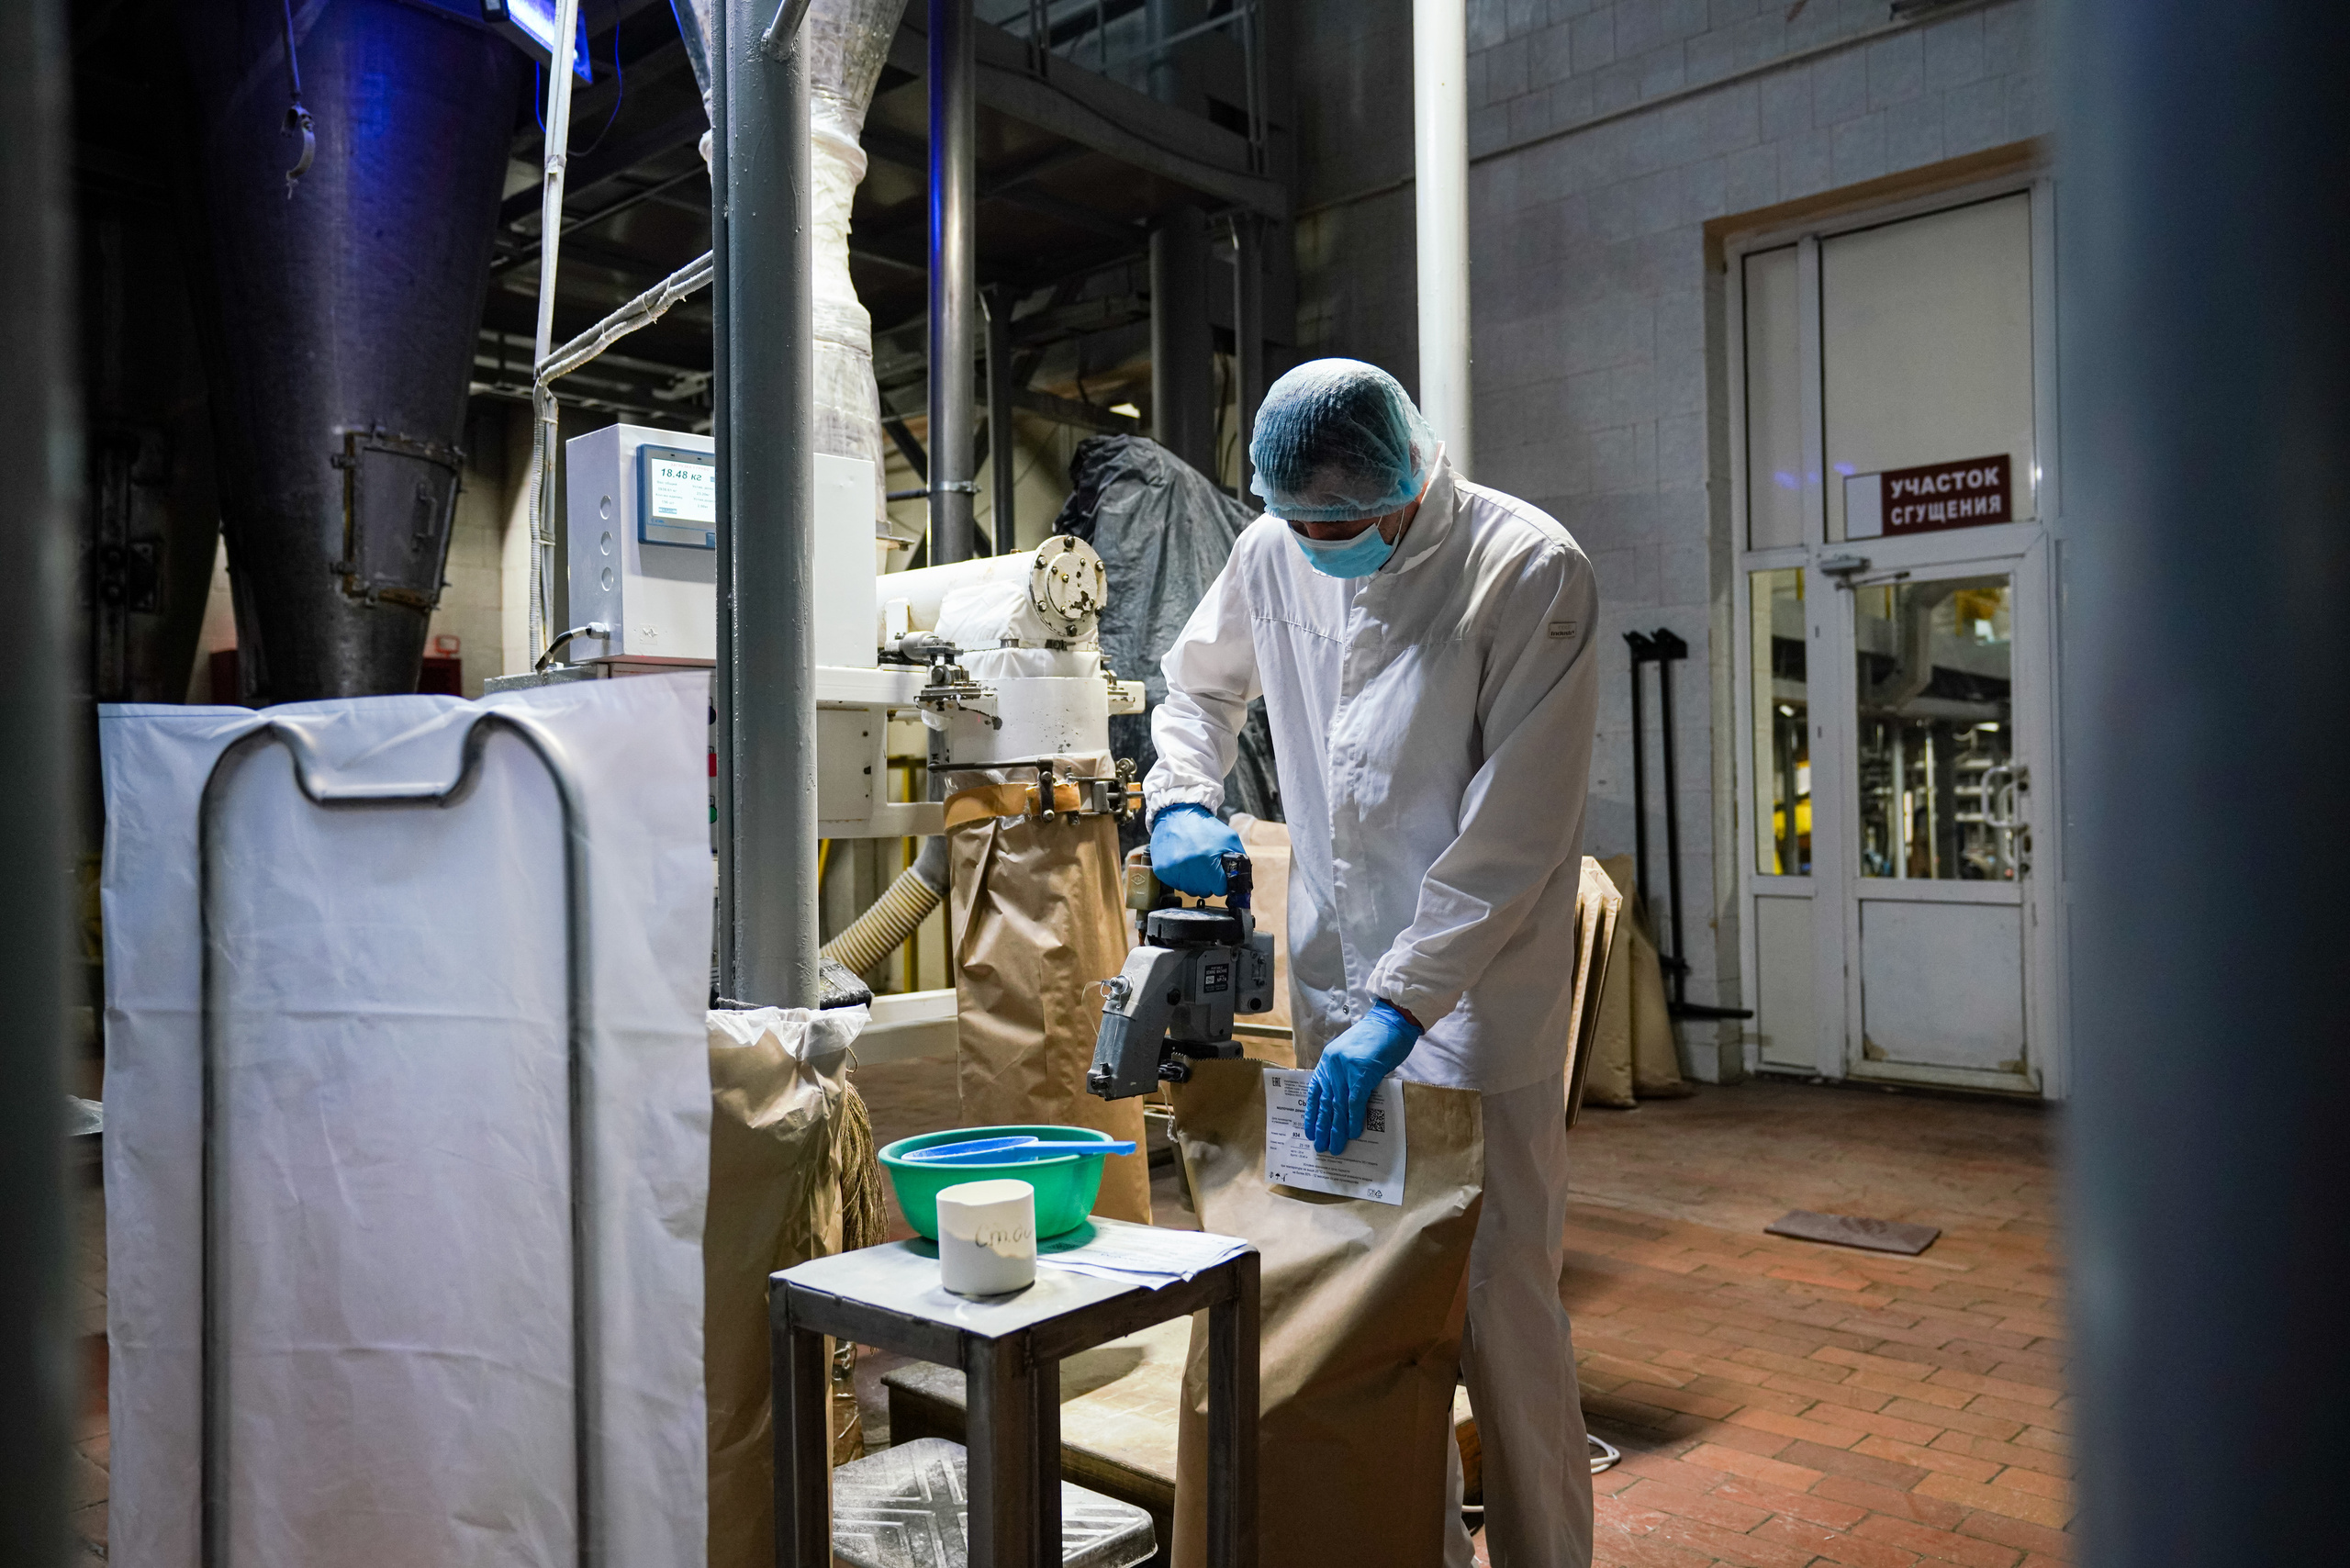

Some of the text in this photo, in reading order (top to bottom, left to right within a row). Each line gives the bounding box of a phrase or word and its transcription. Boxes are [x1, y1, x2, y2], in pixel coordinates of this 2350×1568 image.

[661, 468, 688, 479] 18.48
[1890, 465, 2000, 498] УЧАСТОК
[1890, 494, 2002, 526] СГУЩЕНИЯ
